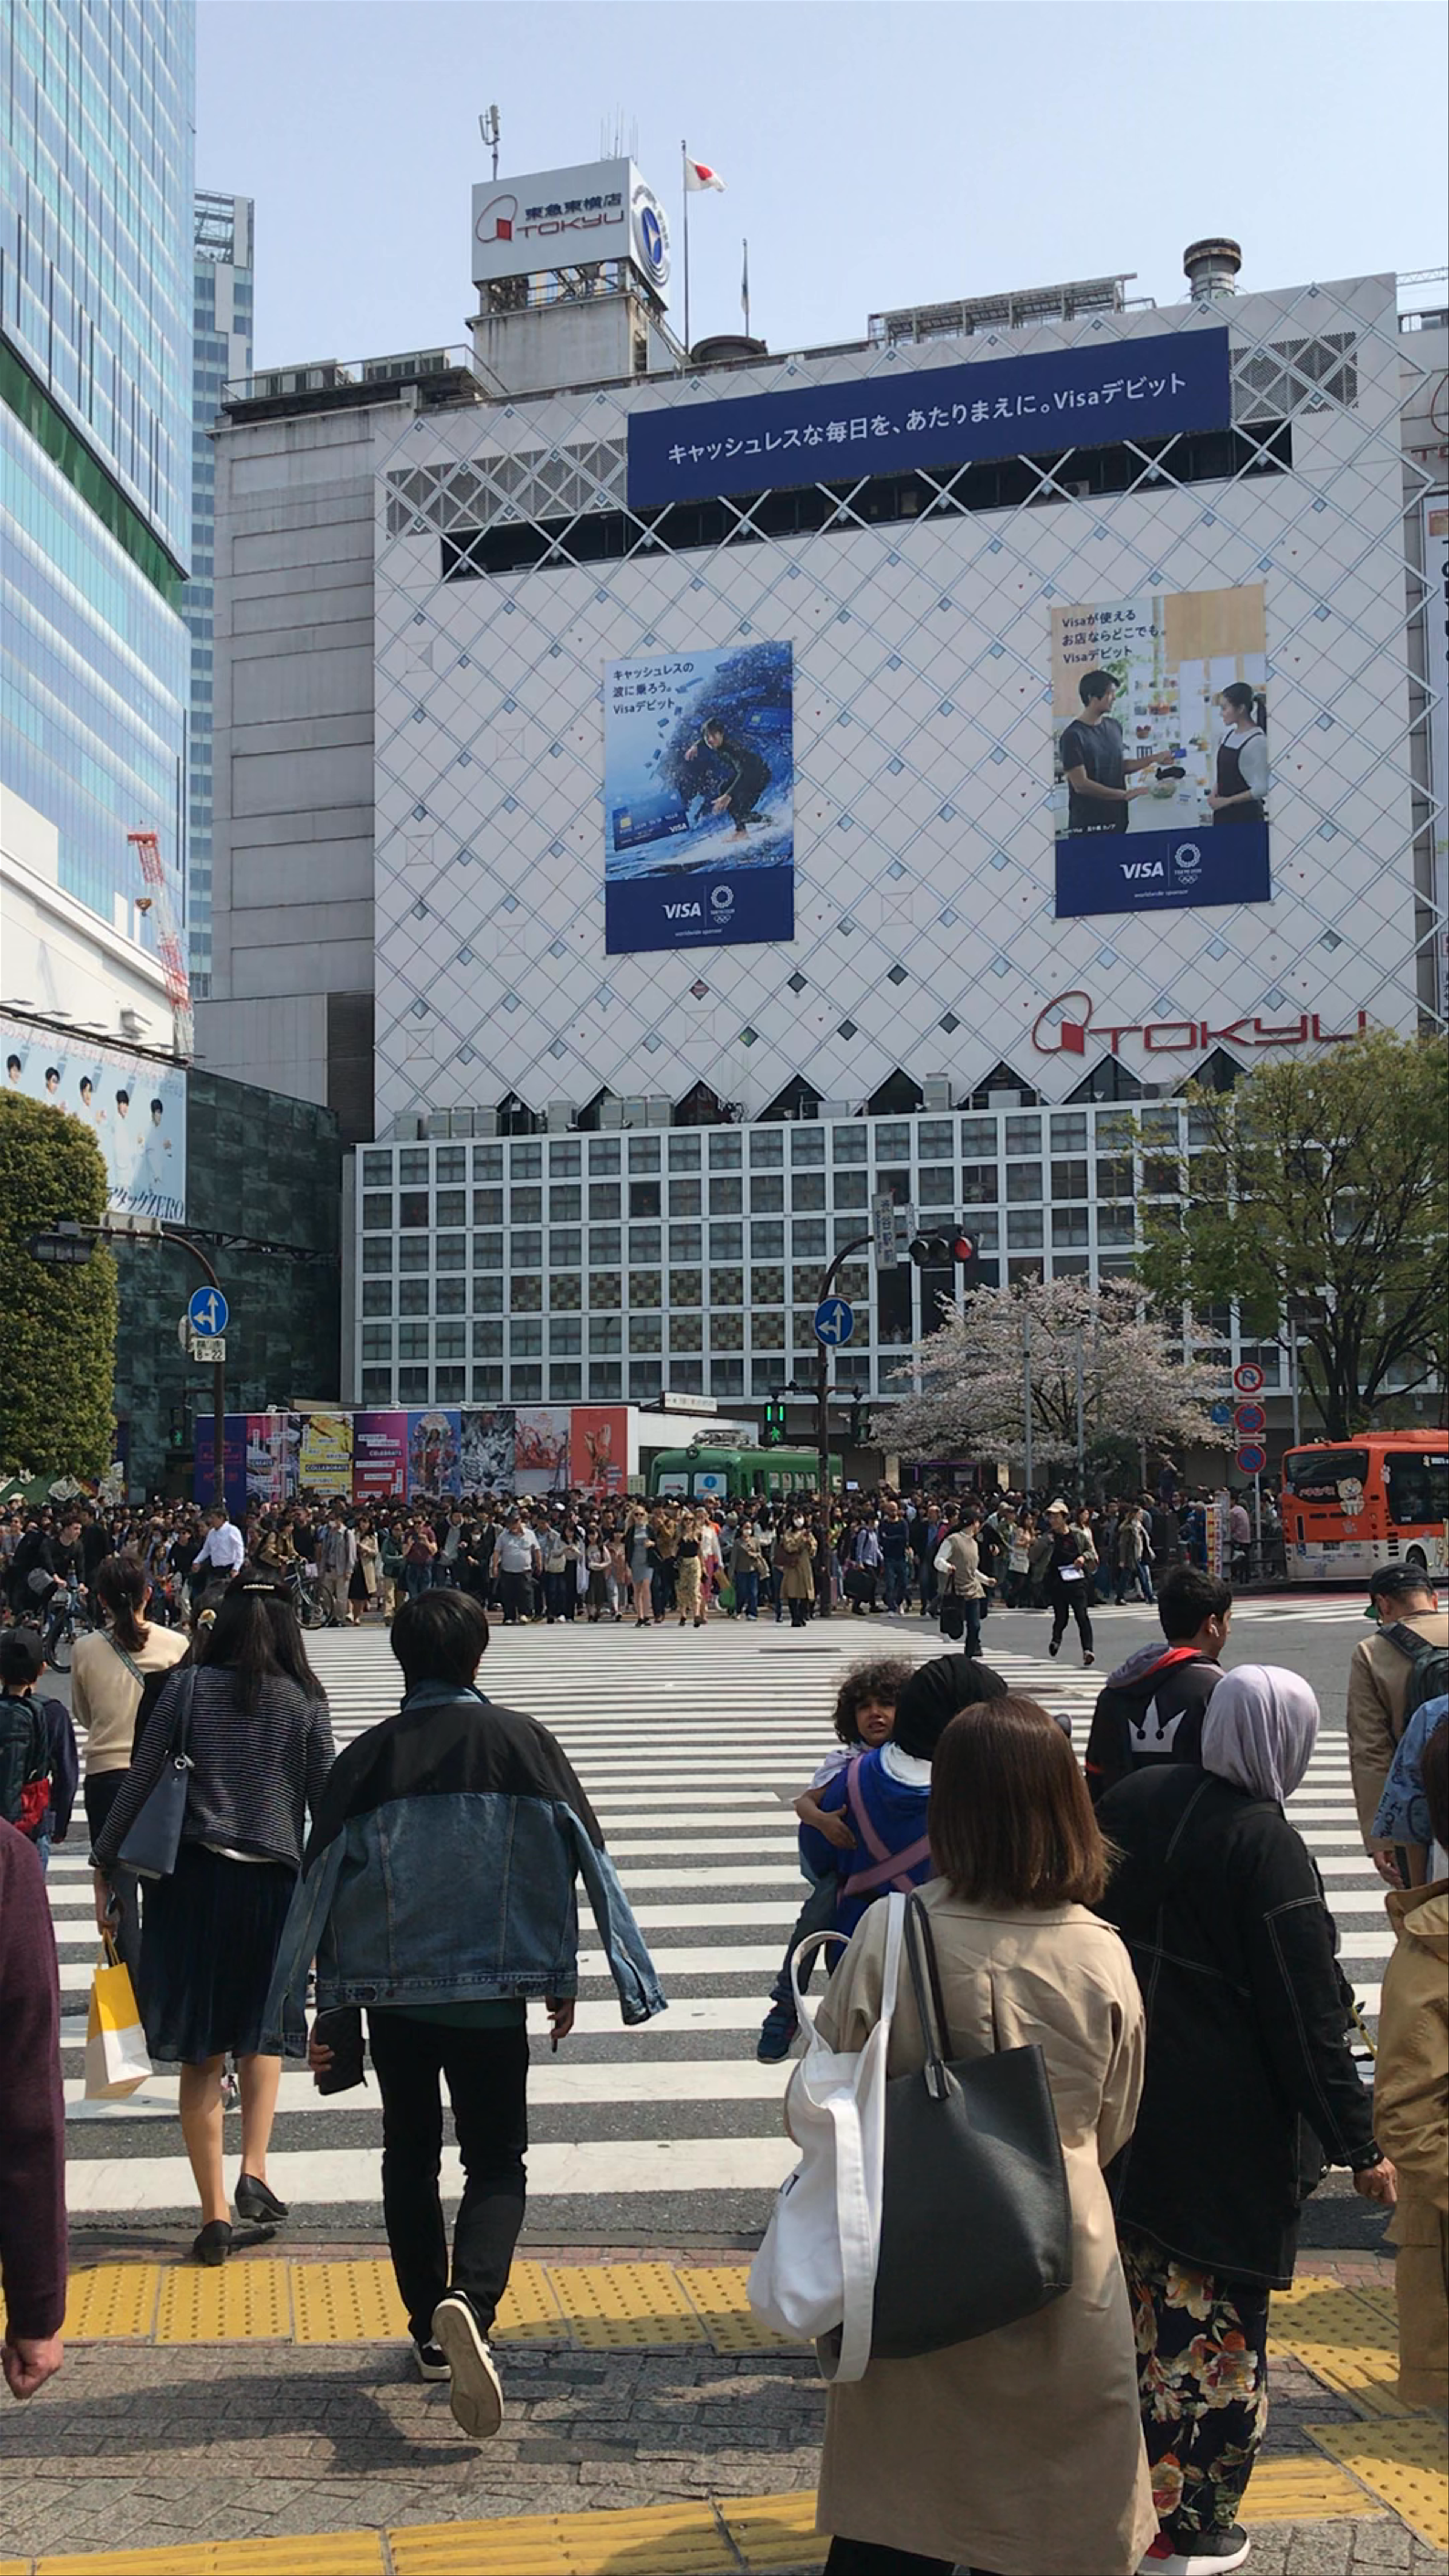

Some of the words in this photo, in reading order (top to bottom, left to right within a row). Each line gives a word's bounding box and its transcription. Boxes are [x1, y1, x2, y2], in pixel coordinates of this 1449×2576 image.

[525, 192, 622, 221] 東急東横店
[517, 210, 624, 238] TOKYU
[1062, 609, 1136, 627] Visaが使える
[1062, 624, 1167, 646] お店ならどこでも。
[1063, 646, 1132, 664] Visaデビット
[613, 662, 694, 680] キャッシュレスの
[613, 682, 672, 698] 波に乗ろう。
[613, 698, 675, 714] Visaデビット
[1120, 861, 1164, 879] VISA
[661, 902, 701, 919] VISA
[1089, 1010, 1365, 1055] TOKYU
